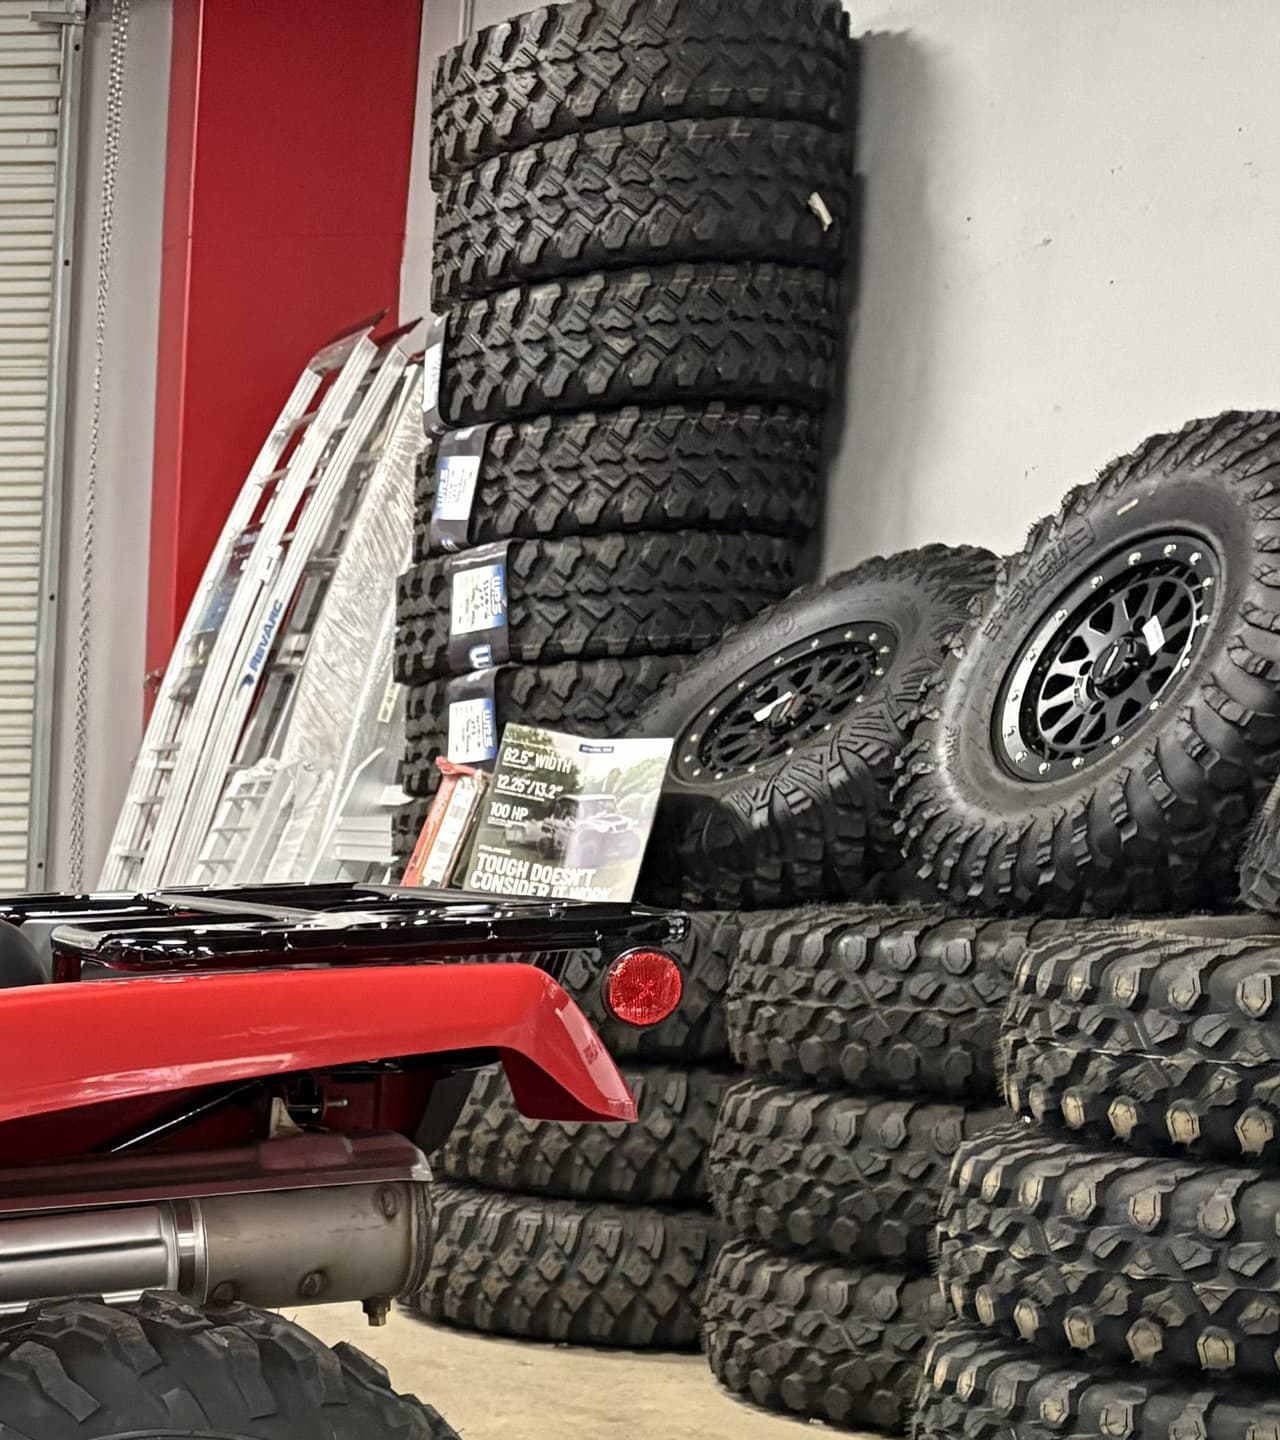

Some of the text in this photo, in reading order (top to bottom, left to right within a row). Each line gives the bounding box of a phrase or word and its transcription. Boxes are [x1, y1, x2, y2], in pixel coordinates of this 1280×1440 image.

[490, 575, 503, 617] WPS
[482, 709, 494, 750] WPS
[503, 747, 535, 766] 62.5"
[535, 752, 572, 774] WIDTH
[490, 802, 529, 821] 100 HP
[471, 870, 550, 898] CONSIDER
[477, 853, 597, 888] TOUGH DOESN'T
